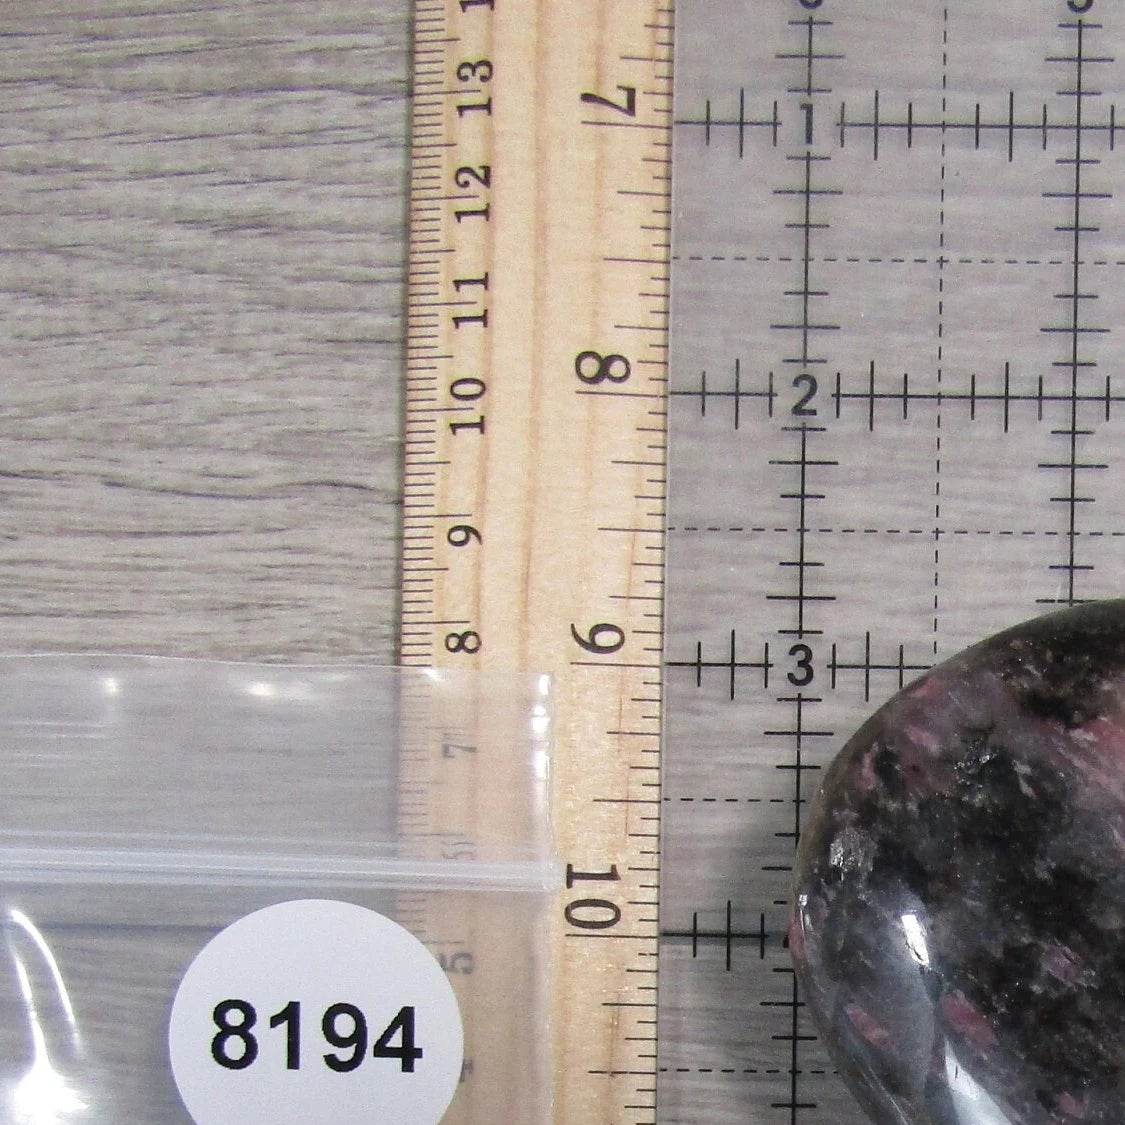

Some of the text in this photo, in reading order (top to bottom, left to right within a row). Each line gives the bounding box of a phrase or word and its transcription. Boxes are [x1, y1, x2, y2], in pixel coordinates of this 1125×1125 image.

[456, 58, 494, 119] 13
[580, 85, 637, 118] 7
[800, 103, 813, 144] 1
[455, 164, 490, 224] 12
[453, 272, 488, 330] 11
[574, 350, 632, 385] 8
[450, 376, 486, 436] 10
[791, 374, 818, 416] 2
[447, 524, 482, 547] 9
[444, 630, 482, 654] 8
[570, 622, 625, 655] 9
[786, 643, 815, 687] 3
[564, 863, 622, 930] 10
[209, 998, 424, 1074] 8194
